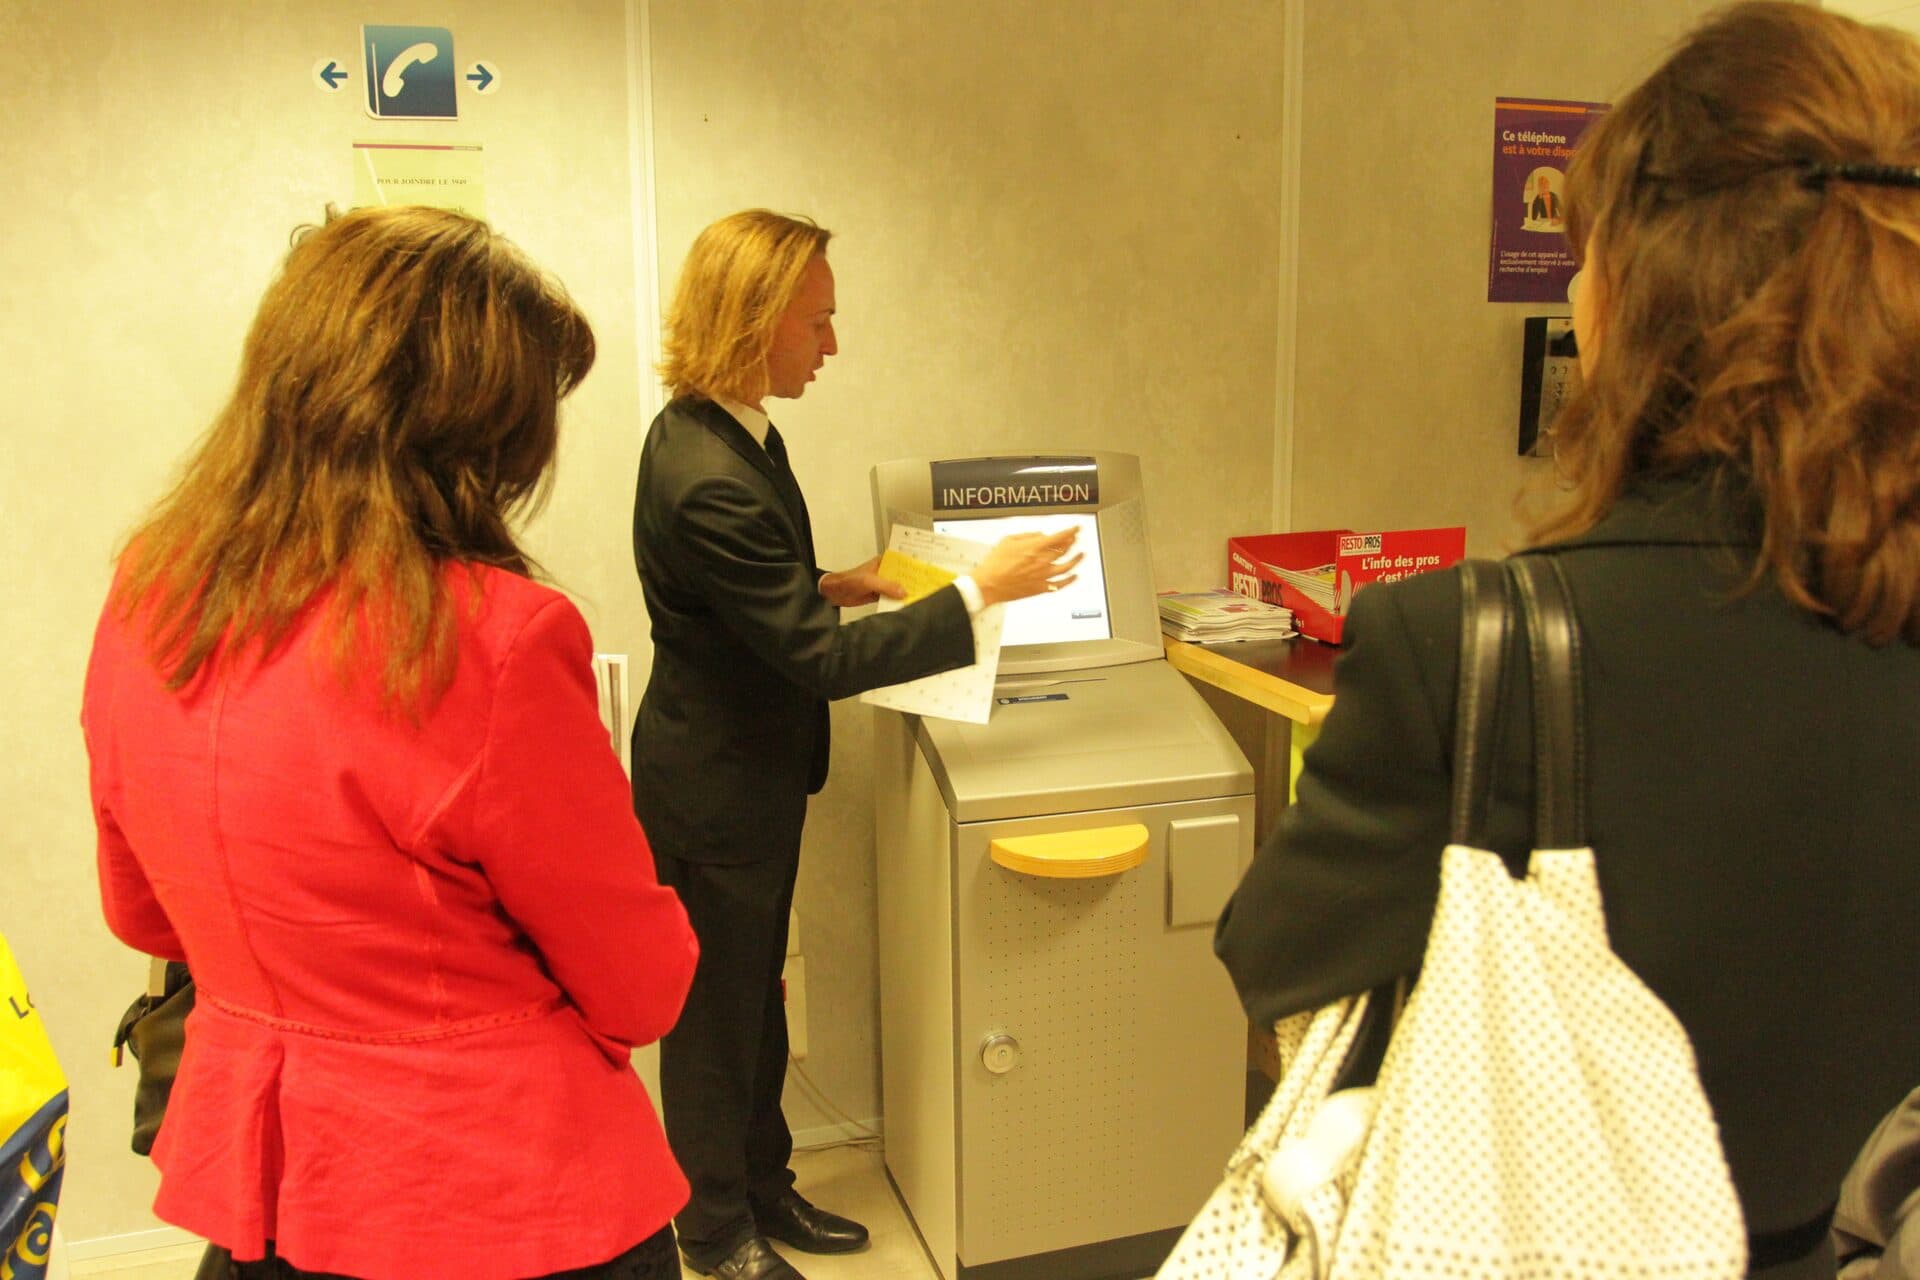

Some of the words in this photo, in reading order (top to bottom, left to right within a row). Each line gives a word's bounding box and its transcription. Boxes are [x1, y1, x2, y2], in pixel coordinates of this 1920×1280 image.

[1503, 131, 1515, 142] Ce
[1518, 131, 1566, 145] téléphone
[1503, 146, 1517, 155] est
[1519, 144, 1525, 155] à
[1527, 147, 1551, 156] votre
[943, 484, 1089, 507] INFORMATION
[1341, 537, 1363, 550] RESTO
[1364, 536, 1380, 549] PROS
[1362, 556, 1392, 570] L'info
[1395, 555, 1414, 567] des
[1416, 556, 1440, 569] pros
[1376, 571, 1402, 584] c'est
[1233, 571, 1259, 601] RESTO
